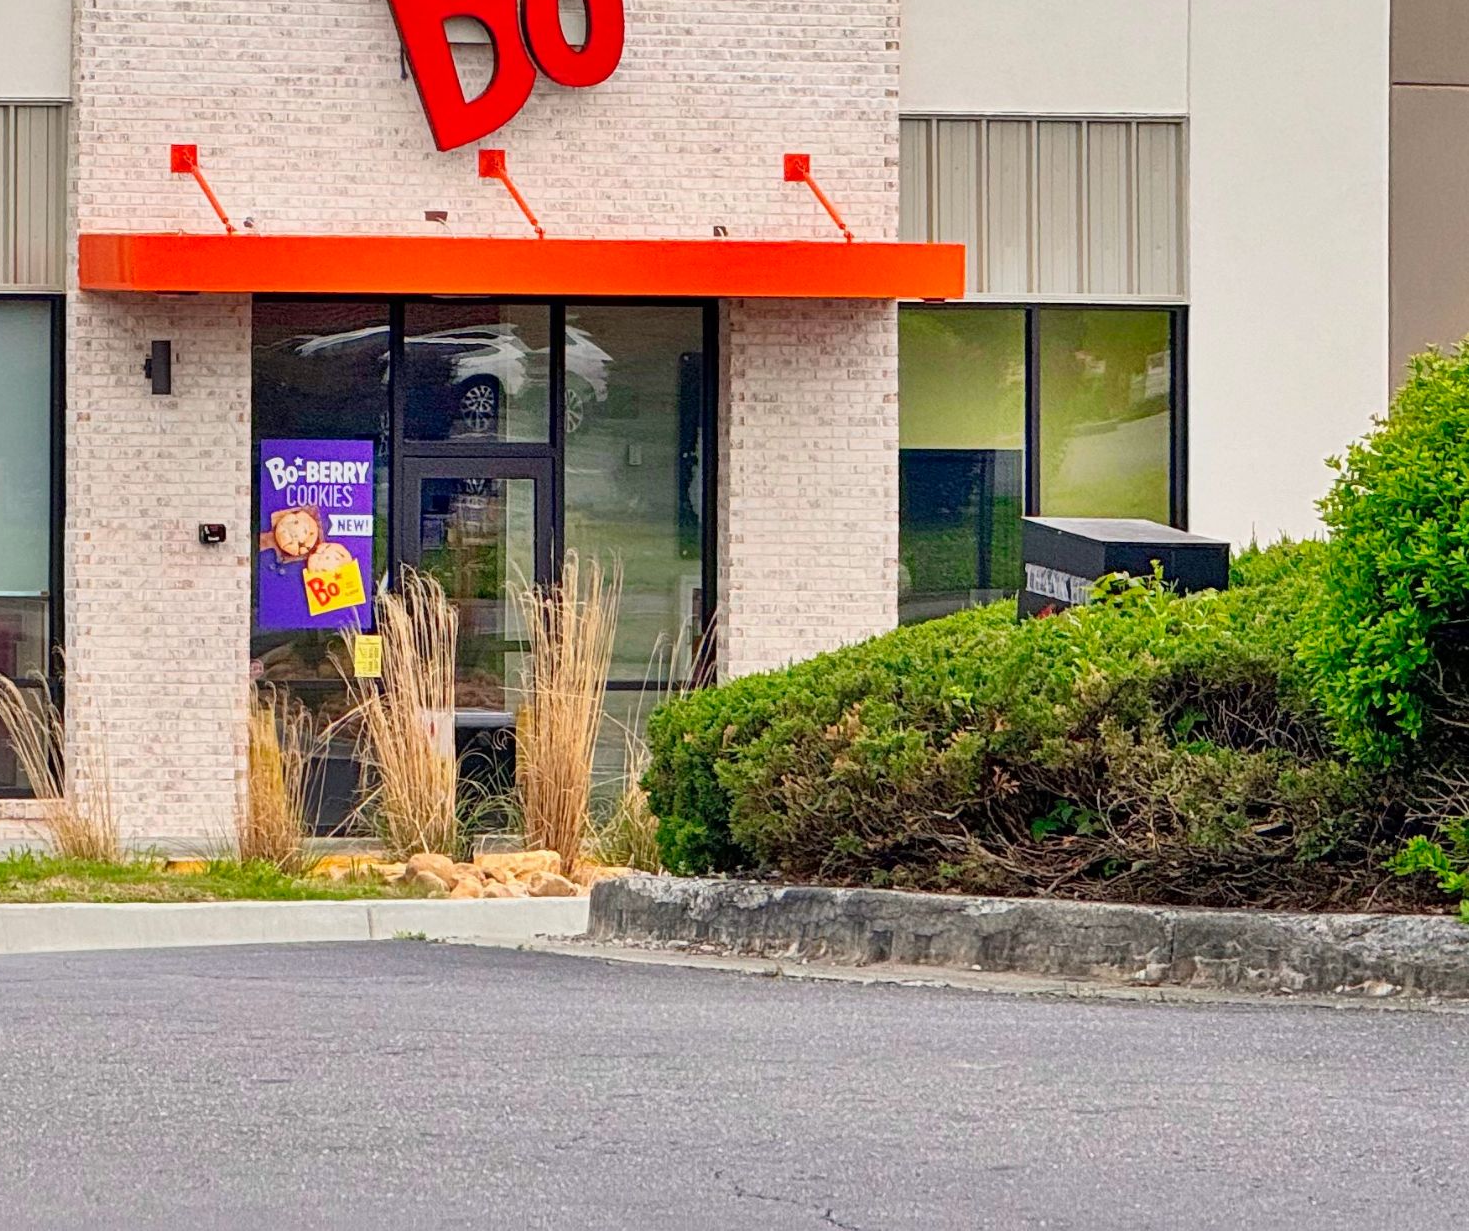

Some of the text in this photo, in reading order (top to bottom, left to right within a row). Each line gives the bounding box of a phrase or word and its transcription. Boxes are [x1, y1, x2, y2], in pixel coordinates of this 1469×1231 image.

[265, 457, 369, 490] Bo-BERRY
[286, 484, 353, 507] COOKIES
[337, 519, 369, 532] NEW!
[307, 577, 341, 607] Bo
